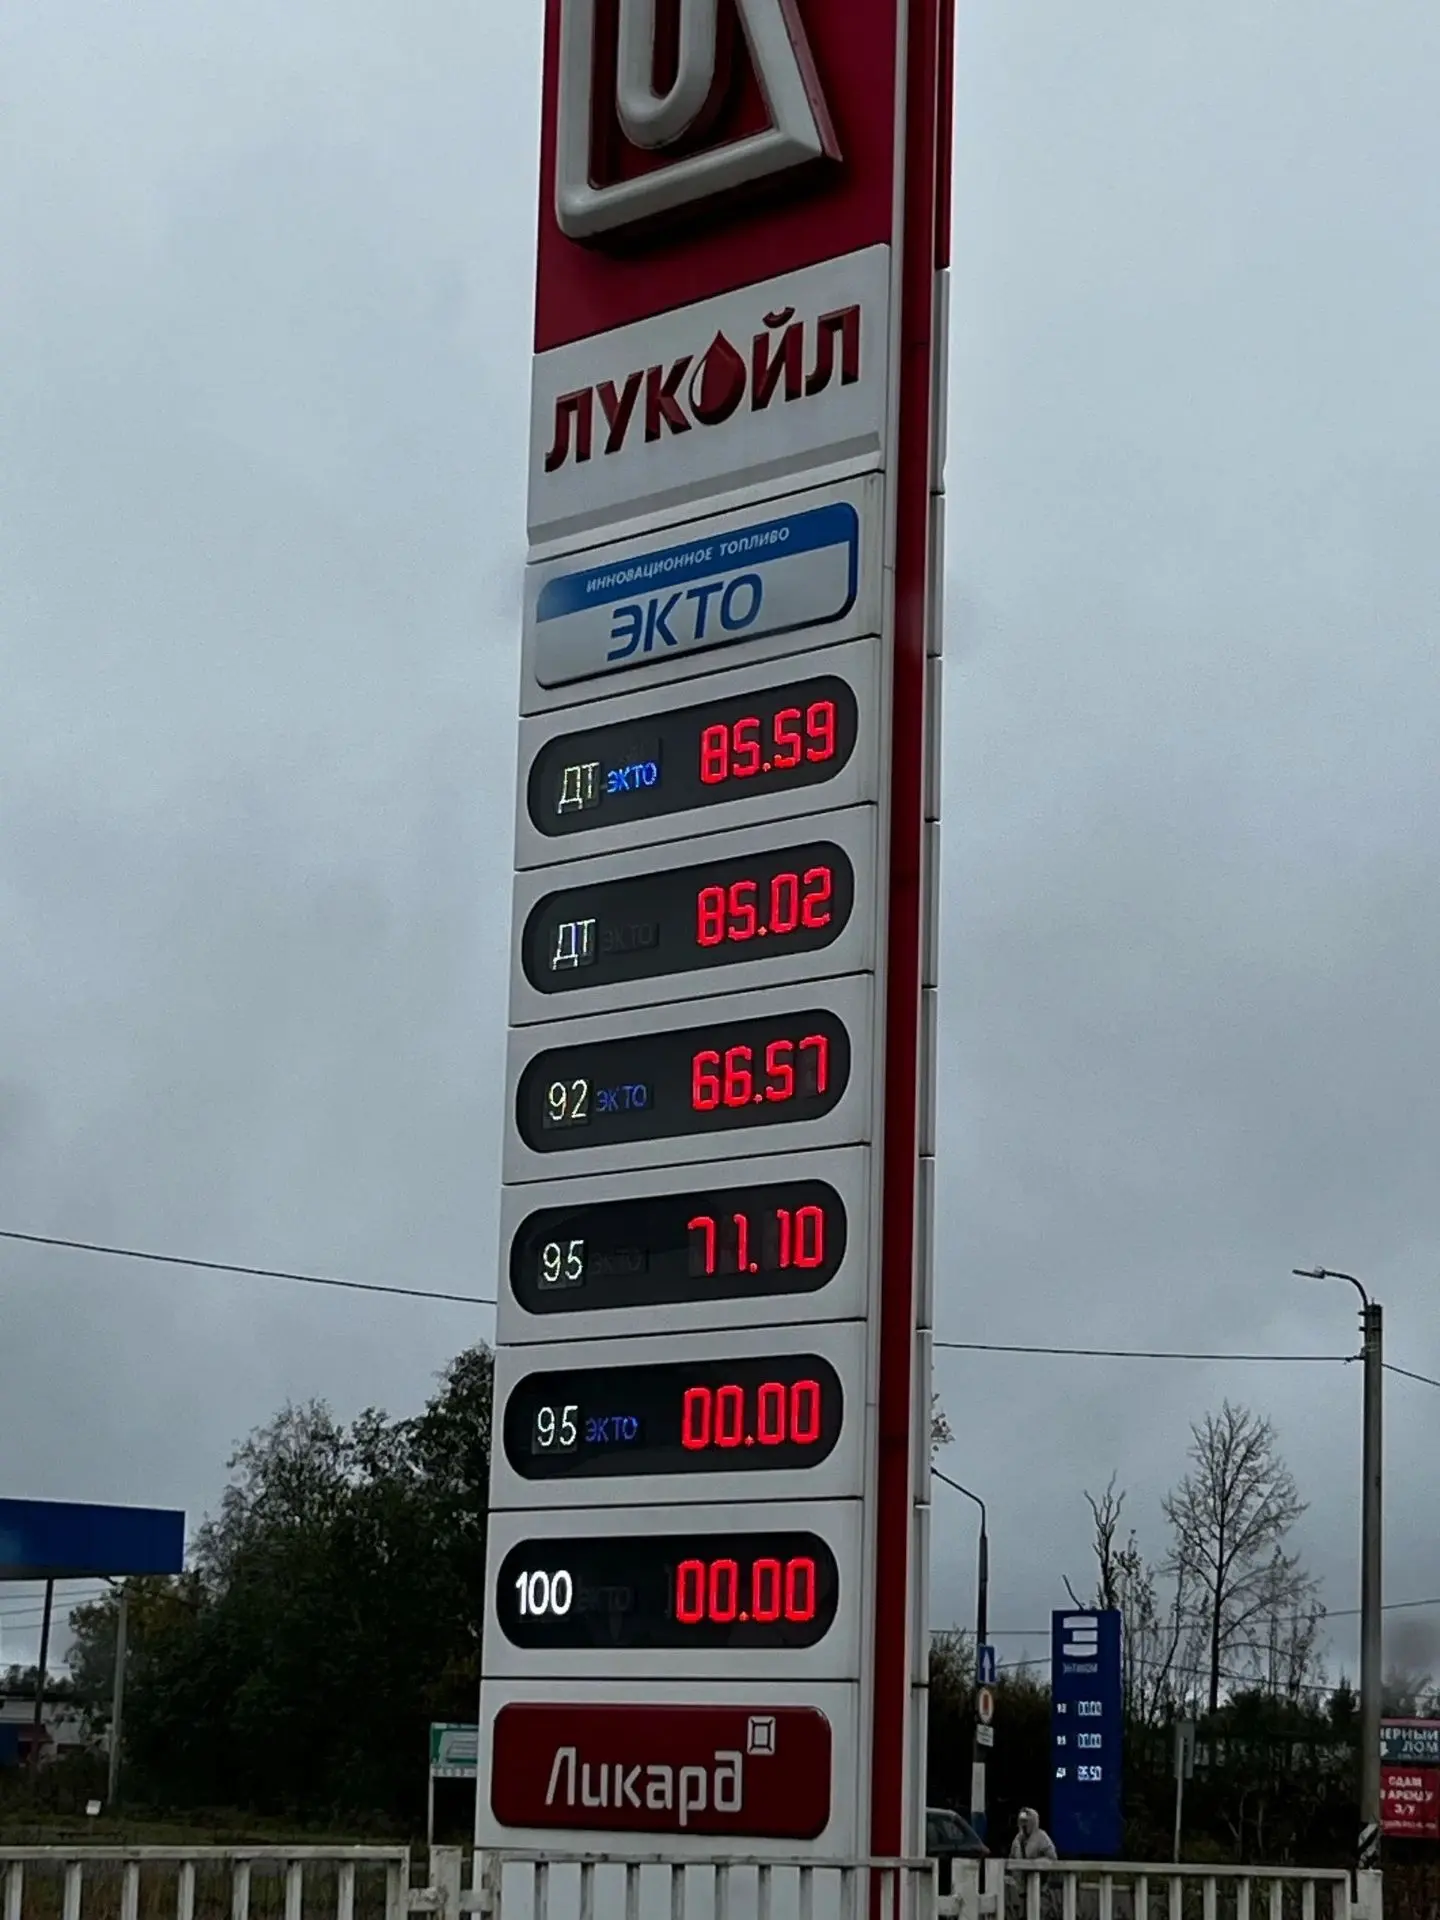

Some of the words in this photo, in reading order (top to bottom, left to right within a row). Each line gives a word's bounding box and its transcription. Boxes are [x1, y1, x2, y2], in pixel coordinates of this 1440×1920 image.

[545, 304, 860, 473] ЛУКОЙЛ
[586, 547, 714, 593] ИННОВАЦИОННОЕ
[719, 527, 790, 556] ТОПЛИВО
[606, 572, 764, 662] ЭКТО
[557, 761, 600, 814] ДТ
[606, 759, 658, 793] ЭКТО
[700, 700, 835, 784] 85.59
[552, 918, 596, 971] ДТ
[696, 866, 832, 947] 85.02
[548, 1079, 588, 1121] 92
[596, 1084, 647, 1111] ЭКТО
[692, 1034, 828, 1110] 66.57
[543, 1240, 584, 1282] 95
[687, 1205, 824, 1274] 71.10
[537, 1405, 578, 1446] 95
[585, 1416, 639, 1442] ЭКТО
[681, 1379, 820, 1449] 00.00
[516, 1570, 573, 1616] 100
[676, 1557, 815, 1623] 00.00
[545, 1746, 743, 1826] Ликард
